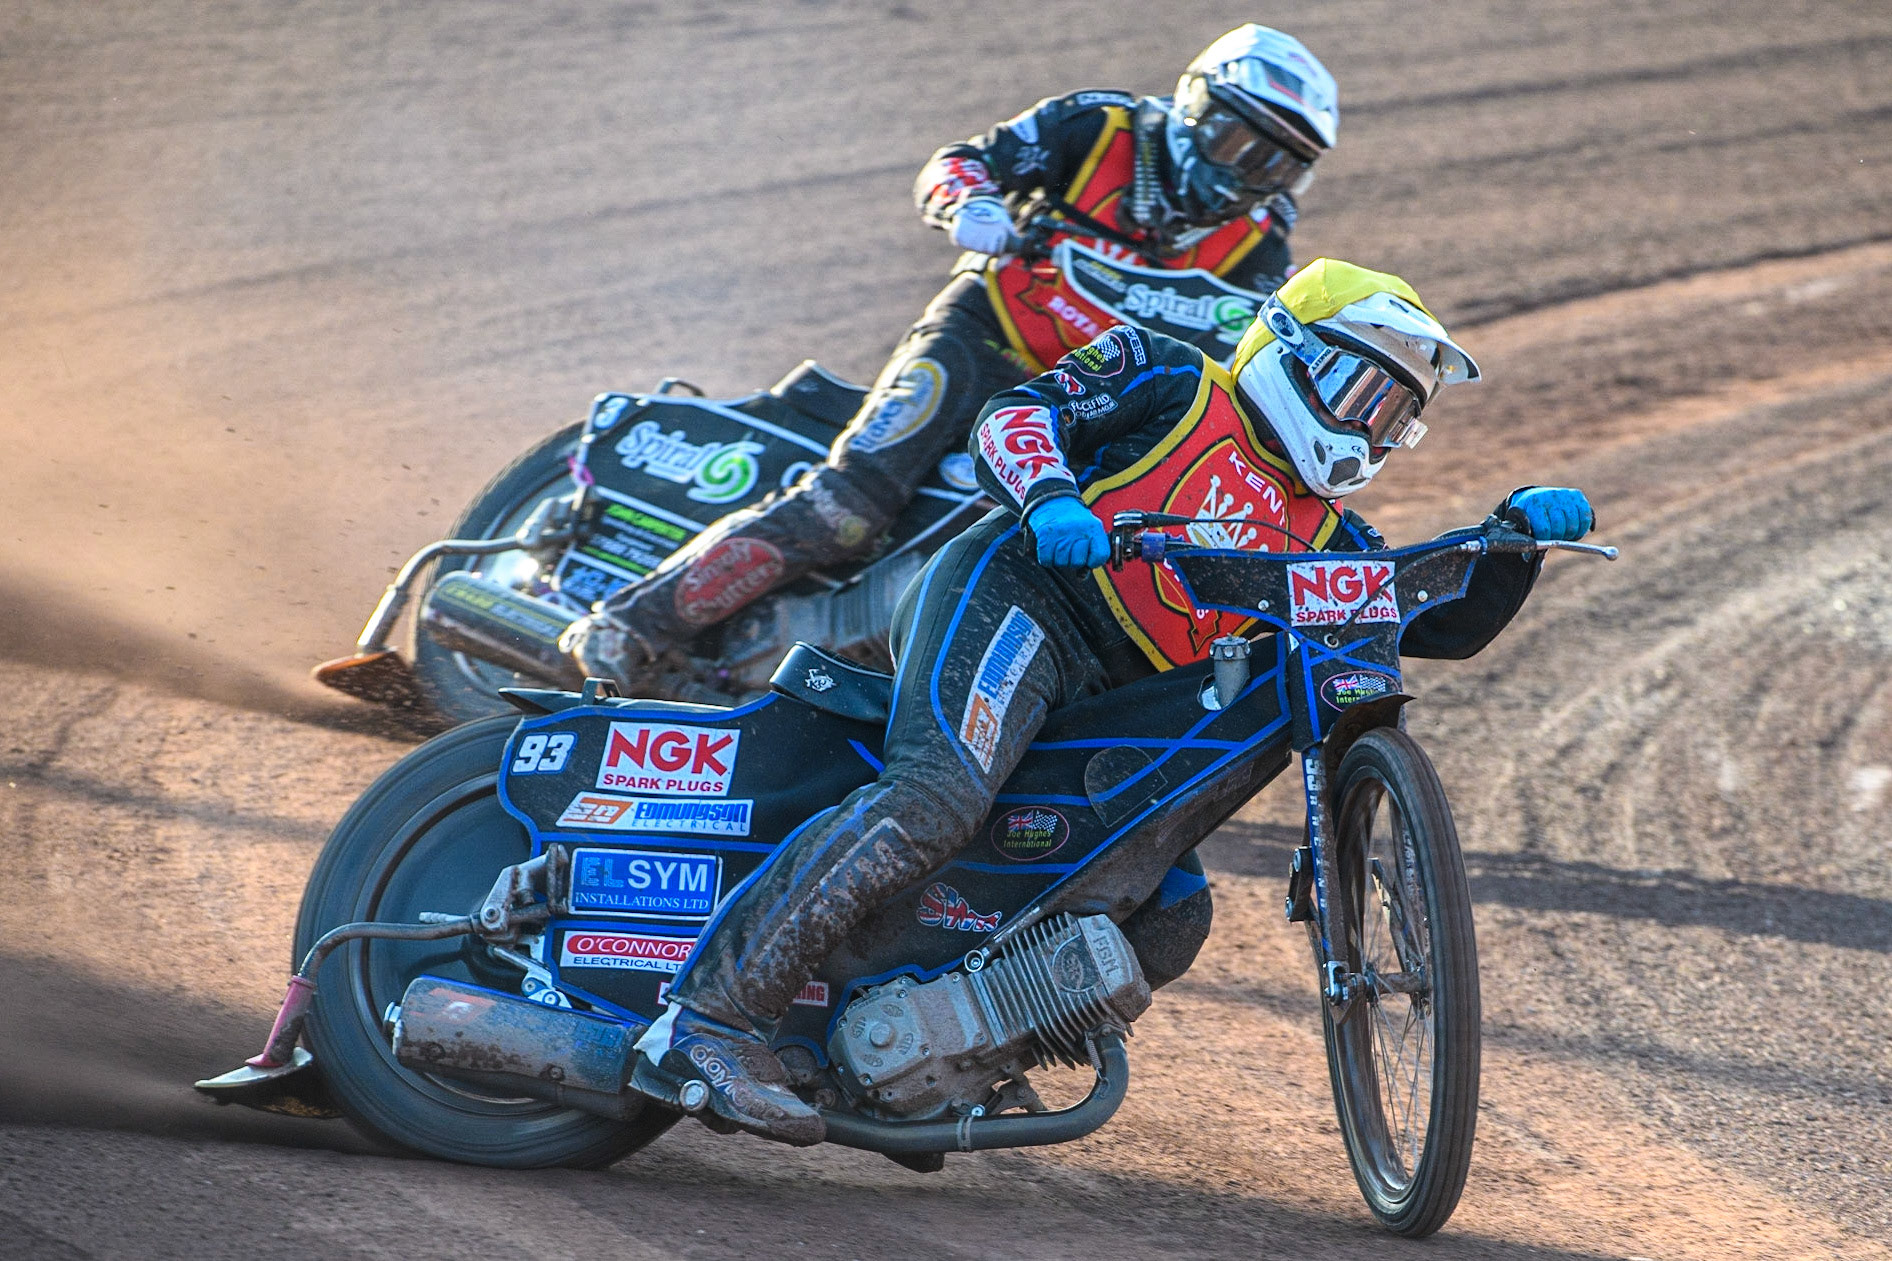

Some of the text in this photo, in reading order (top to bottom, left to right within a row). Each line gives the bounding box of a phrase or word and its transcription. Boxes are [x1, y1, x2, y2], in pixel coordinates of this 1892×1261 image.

[1124, 283, 1213, 326] Spiral
[615, 421, 721, 473] Spiral
[995, 408, 1059, 480] NGK
[980, 423, 1025, 500] SPARK PLUGS
[1292, 566, 1393, 606] NGK
[1296, 609, 1347, 623] SPARK
[512, 733, 576, 773] 93
[606, 729, 734, 777] NGK
[603, 774, 723, 792] SPARK PLUGS
[631, 819, 746, 832] ELECTRICAL
[1006, 830, 1051, 840] Joe Hughes
[1003, 838, 1052, 848] International
[575, 892, 709, 910] INSTALLATIONS LTD
[573, 956, 659, 970] ELECTRICAL
